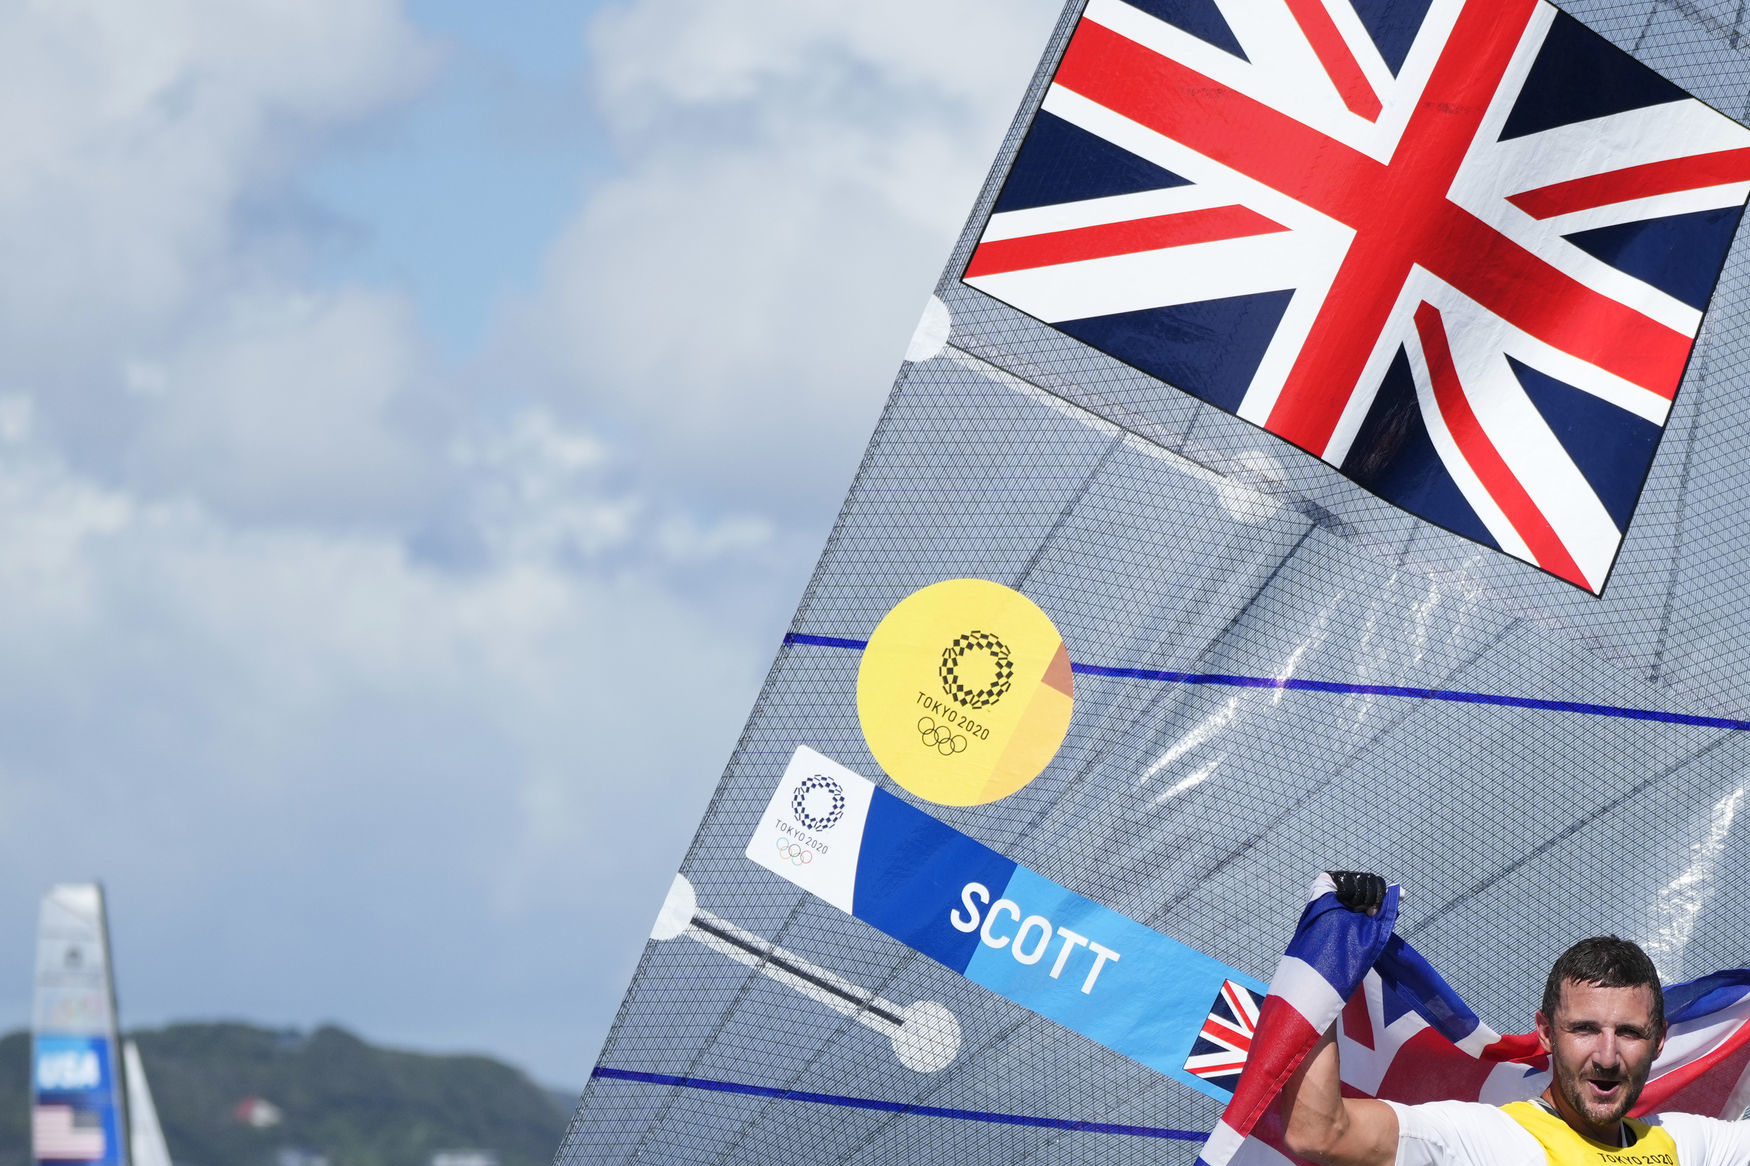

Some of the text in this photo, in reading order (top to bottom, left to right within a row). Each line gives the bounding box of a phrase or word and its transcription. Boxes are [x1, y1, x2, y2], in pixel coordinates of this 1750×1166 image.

[916, 691, 990, 740] TOKYO 2020
[775, 819, 829, 855] TOKYO 2020
[950, 882, 1121, 995] SCOTT
[1597, 1153, 1674, 1166] TOKYO 2020
